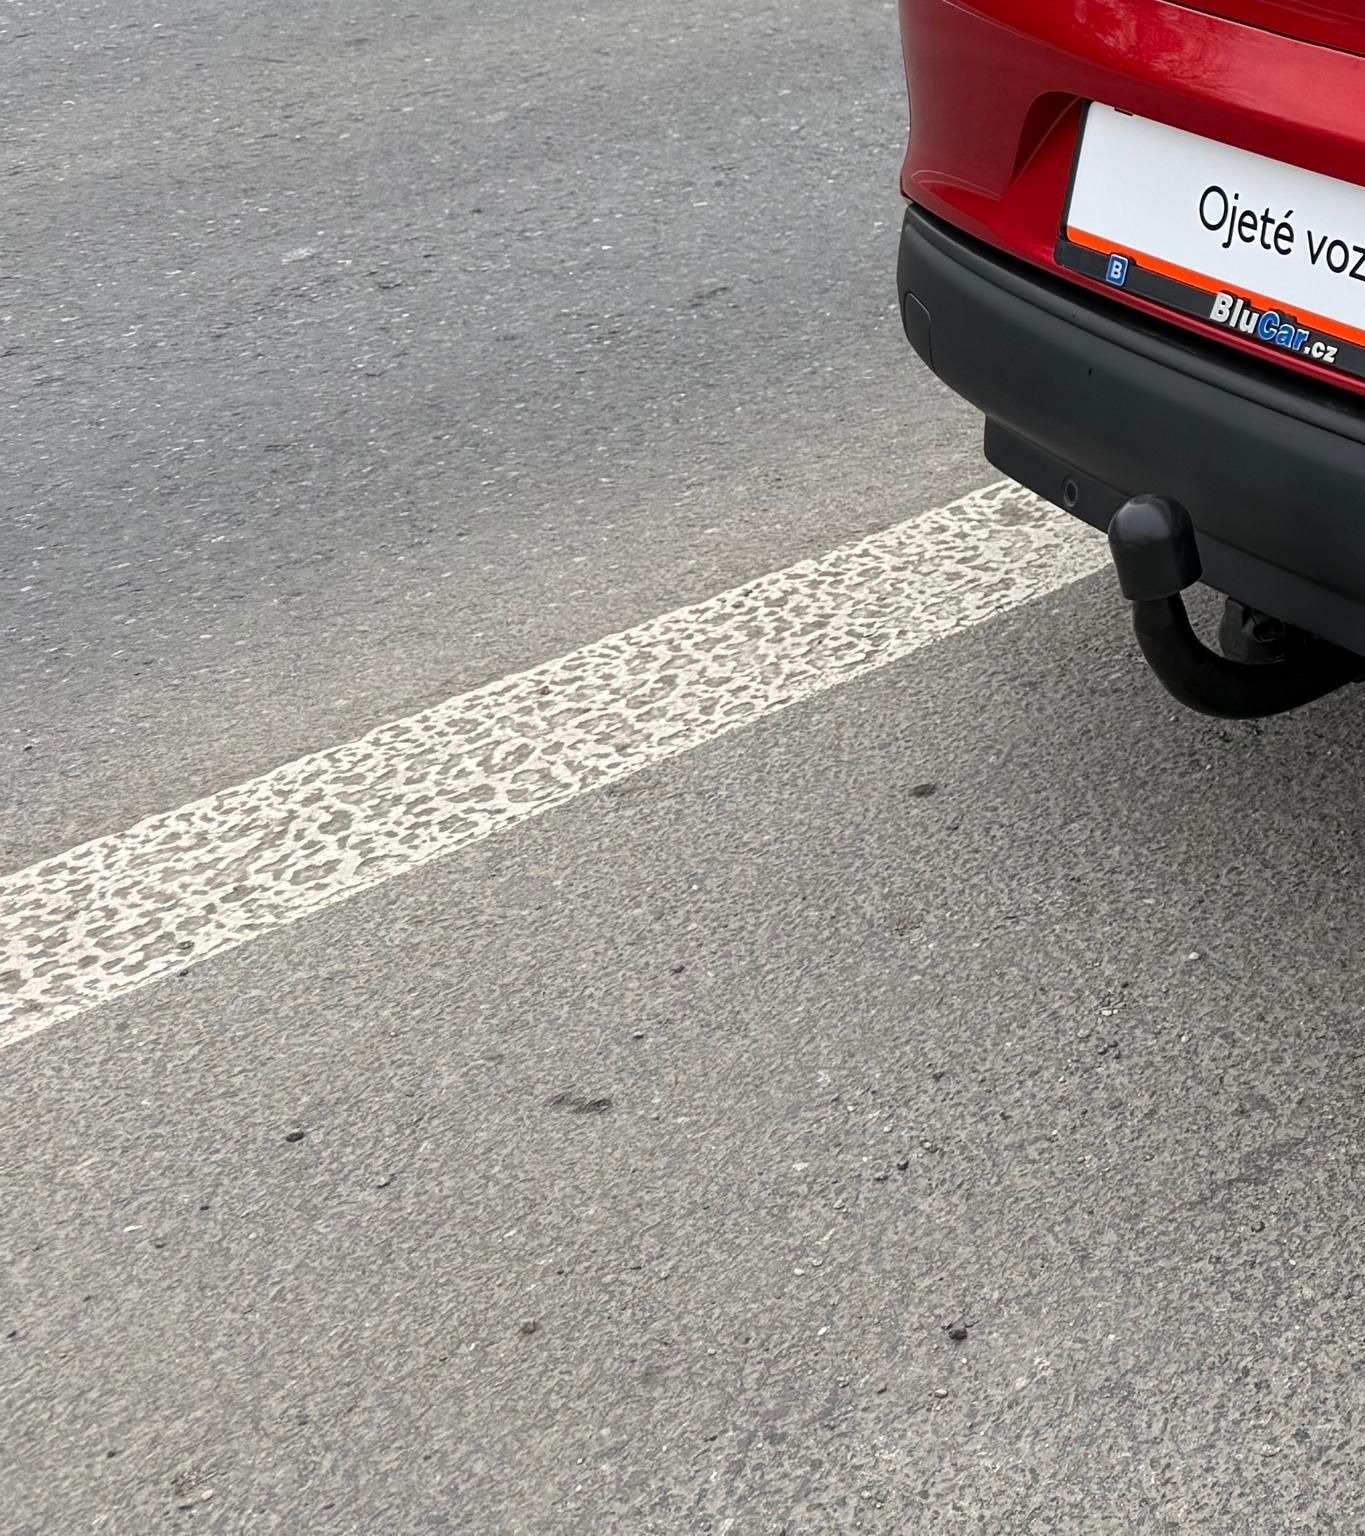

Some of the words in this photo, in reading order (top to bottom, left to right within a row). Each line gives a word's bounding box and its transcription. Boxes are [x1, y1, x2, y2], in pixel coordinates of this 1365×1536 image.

[1199, 185, 1295, 256] Ojeté
[1110, 259, 1124, 280] B
[1209, 291, 1339, 364] BluCar.cz
